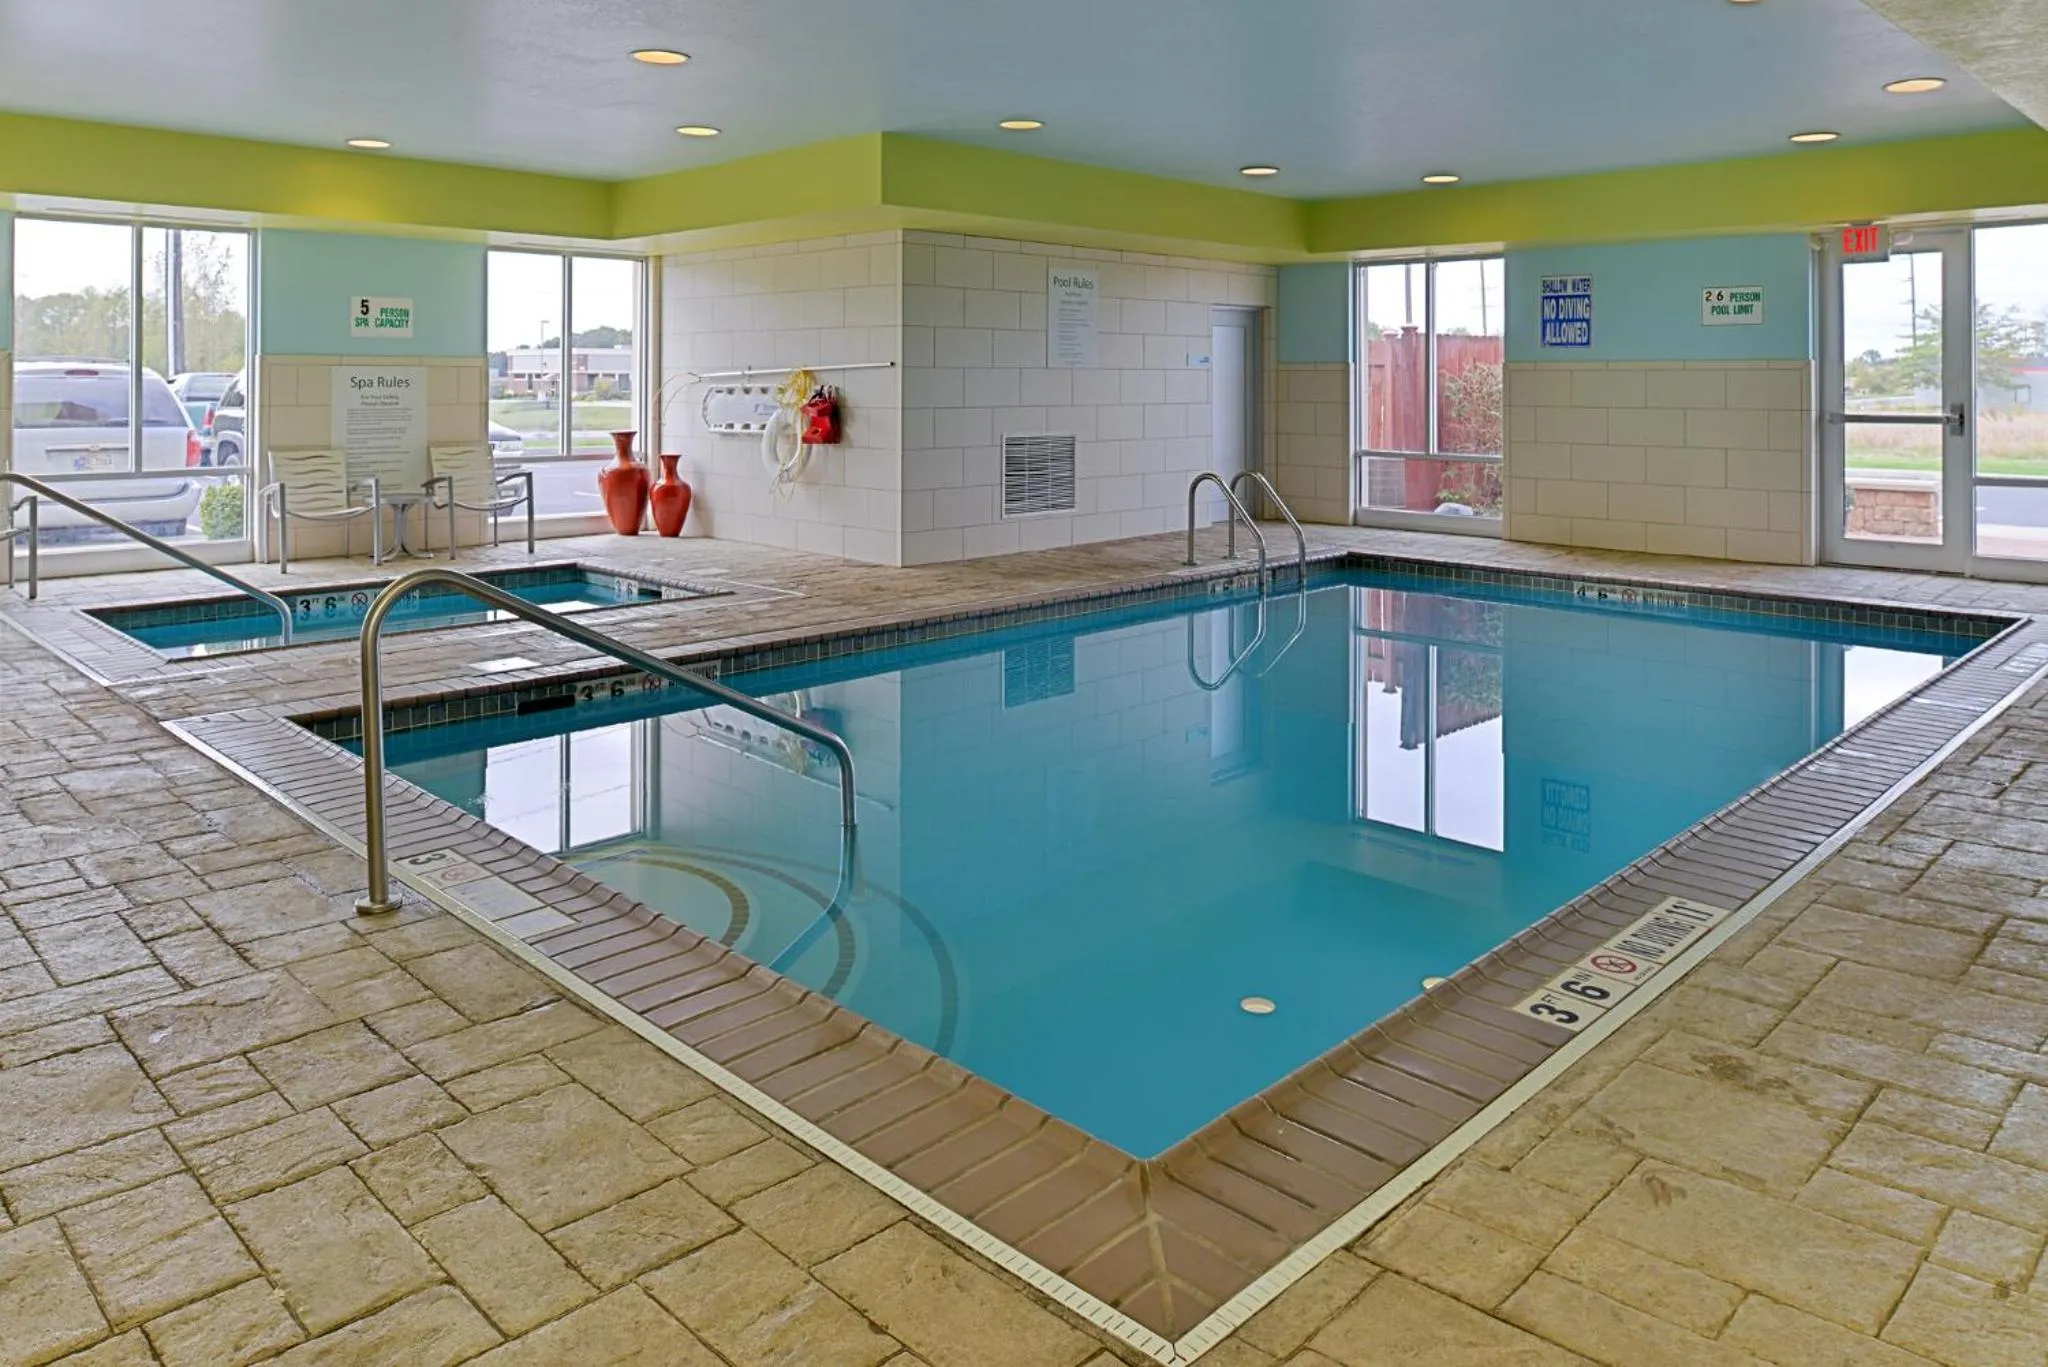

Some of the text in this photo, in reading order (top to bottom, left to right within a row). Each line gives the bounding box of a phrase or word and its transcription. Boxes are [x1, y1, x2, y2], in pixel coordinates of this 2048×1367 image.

[1843, 225, 1879, 253] EXIT
[1053, 275, 1071, 288] Pool
[1729, 291, 1761, 303] PERSON
[361, 298, 410, 318] 5 PERSON
[1544, 298, 1590, 320] NO DIVING
[1711, 304, 1754, 316] POOL LIMIT
[354, 316, 409, 329] SPA CAPACITY
[1545, 321, 1589, 344] ALLOWED
[350, 375, 411, 390] Spa Rules
[299, 599, 311, 613] 3
[408, 853, 447, 866] 3
[1629, 916, 1697, 949] DIVING
[1613, 939, 1667, 961] NO
[1560, 980, 1611, 1000] 6
[1540, 993, 1561, 1006] FT
[1529, 1003, 1579, 1024] 3
